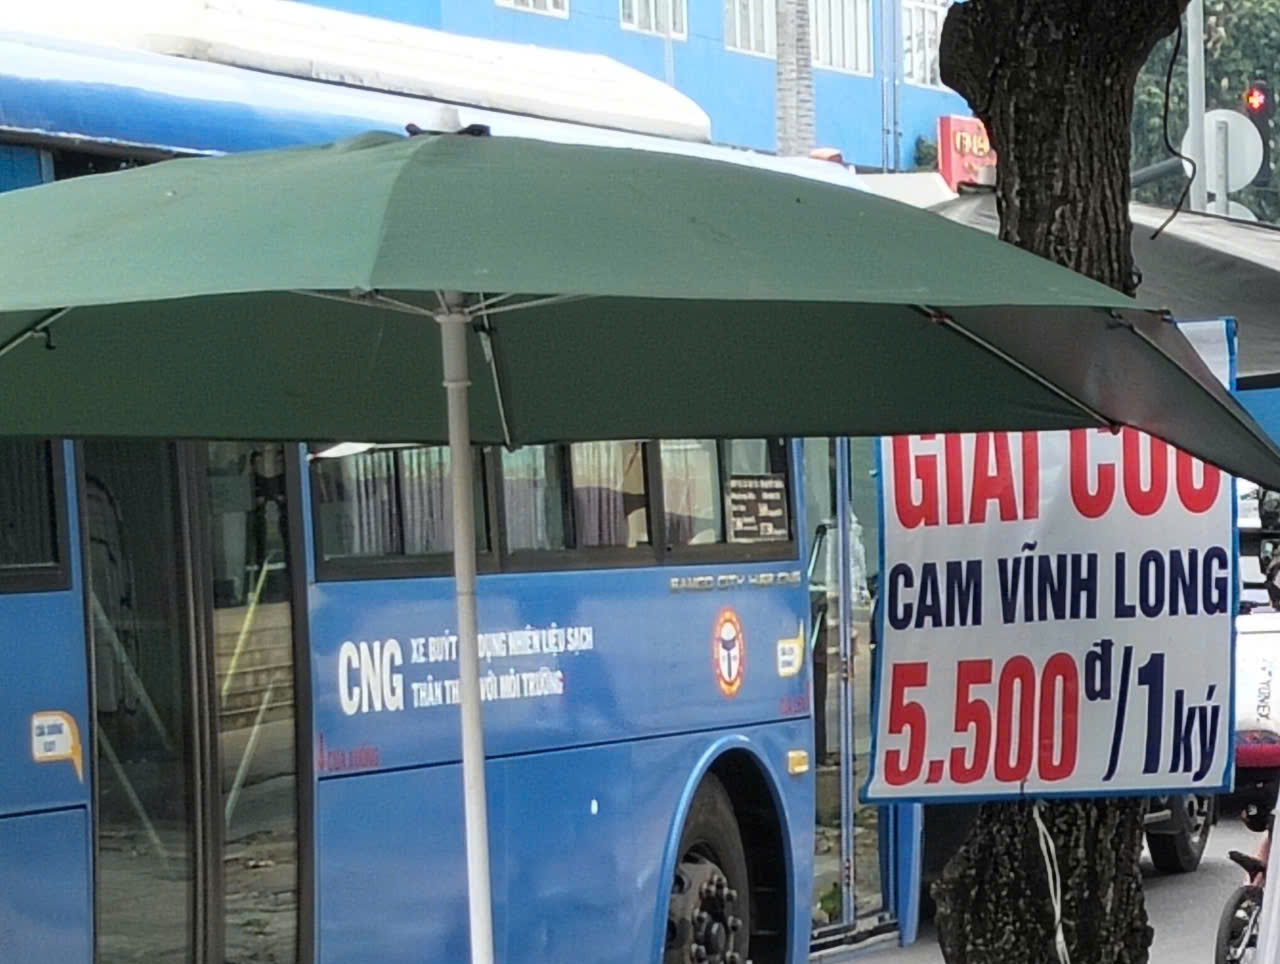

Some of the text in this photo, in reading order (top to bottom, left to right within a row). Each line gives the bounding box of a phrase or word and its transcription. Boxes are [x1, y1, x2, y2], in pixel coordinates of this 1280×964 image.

[887, 541, 1228, 630] CAM VĨNH LONG
[338, 639, 404, 716] CNG
[410, 638, 426, 664] XE
